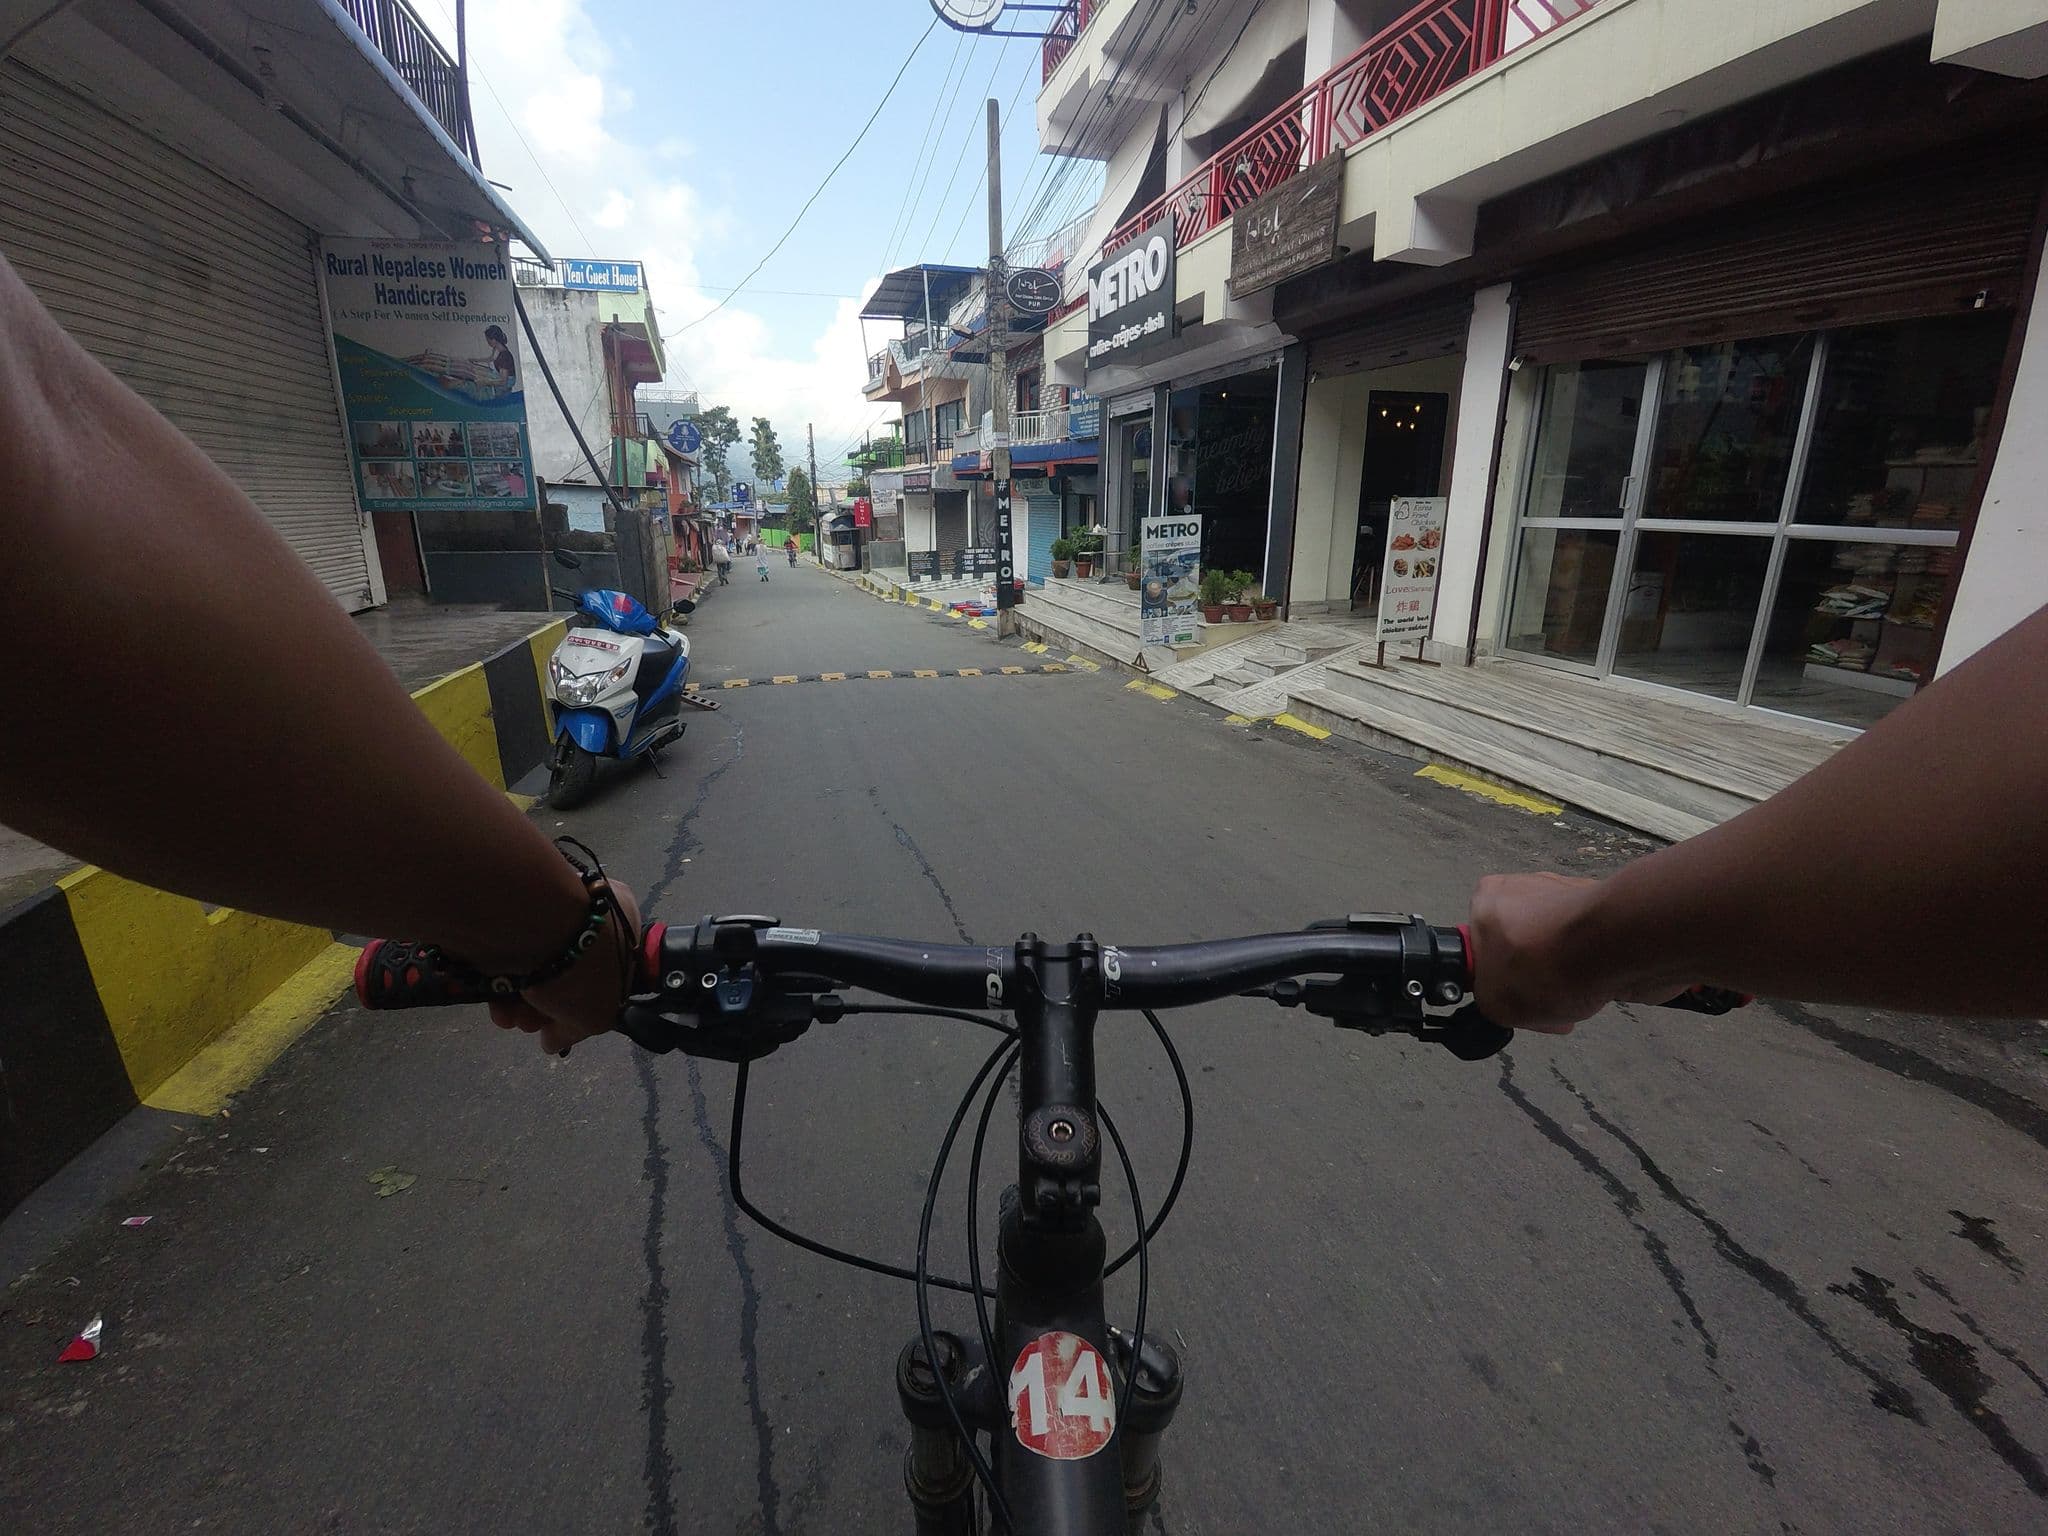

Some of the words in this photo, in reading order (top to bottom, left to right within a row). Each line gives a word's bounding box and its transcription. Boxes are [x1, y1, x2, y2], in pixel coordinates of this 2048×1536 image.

[327, 253, 368, 276] Rural
[373, 255, 445, 282] Nepalese
[449, 257, 507, 280] Women
[586, 264, 610, 285] Guest
[612, 265, 637, 287] House
[1089, 236, 1167, 324] METRO
[374, 283, 467, 308] Handicrafts
[350, 310, 371, 321] Step
[374, 311, 390, 320] For
[431, 312, 450, 321] Self
[1147, 522, 1199, 539] METRO
[1010, 1350, 1115, 1436] 14
